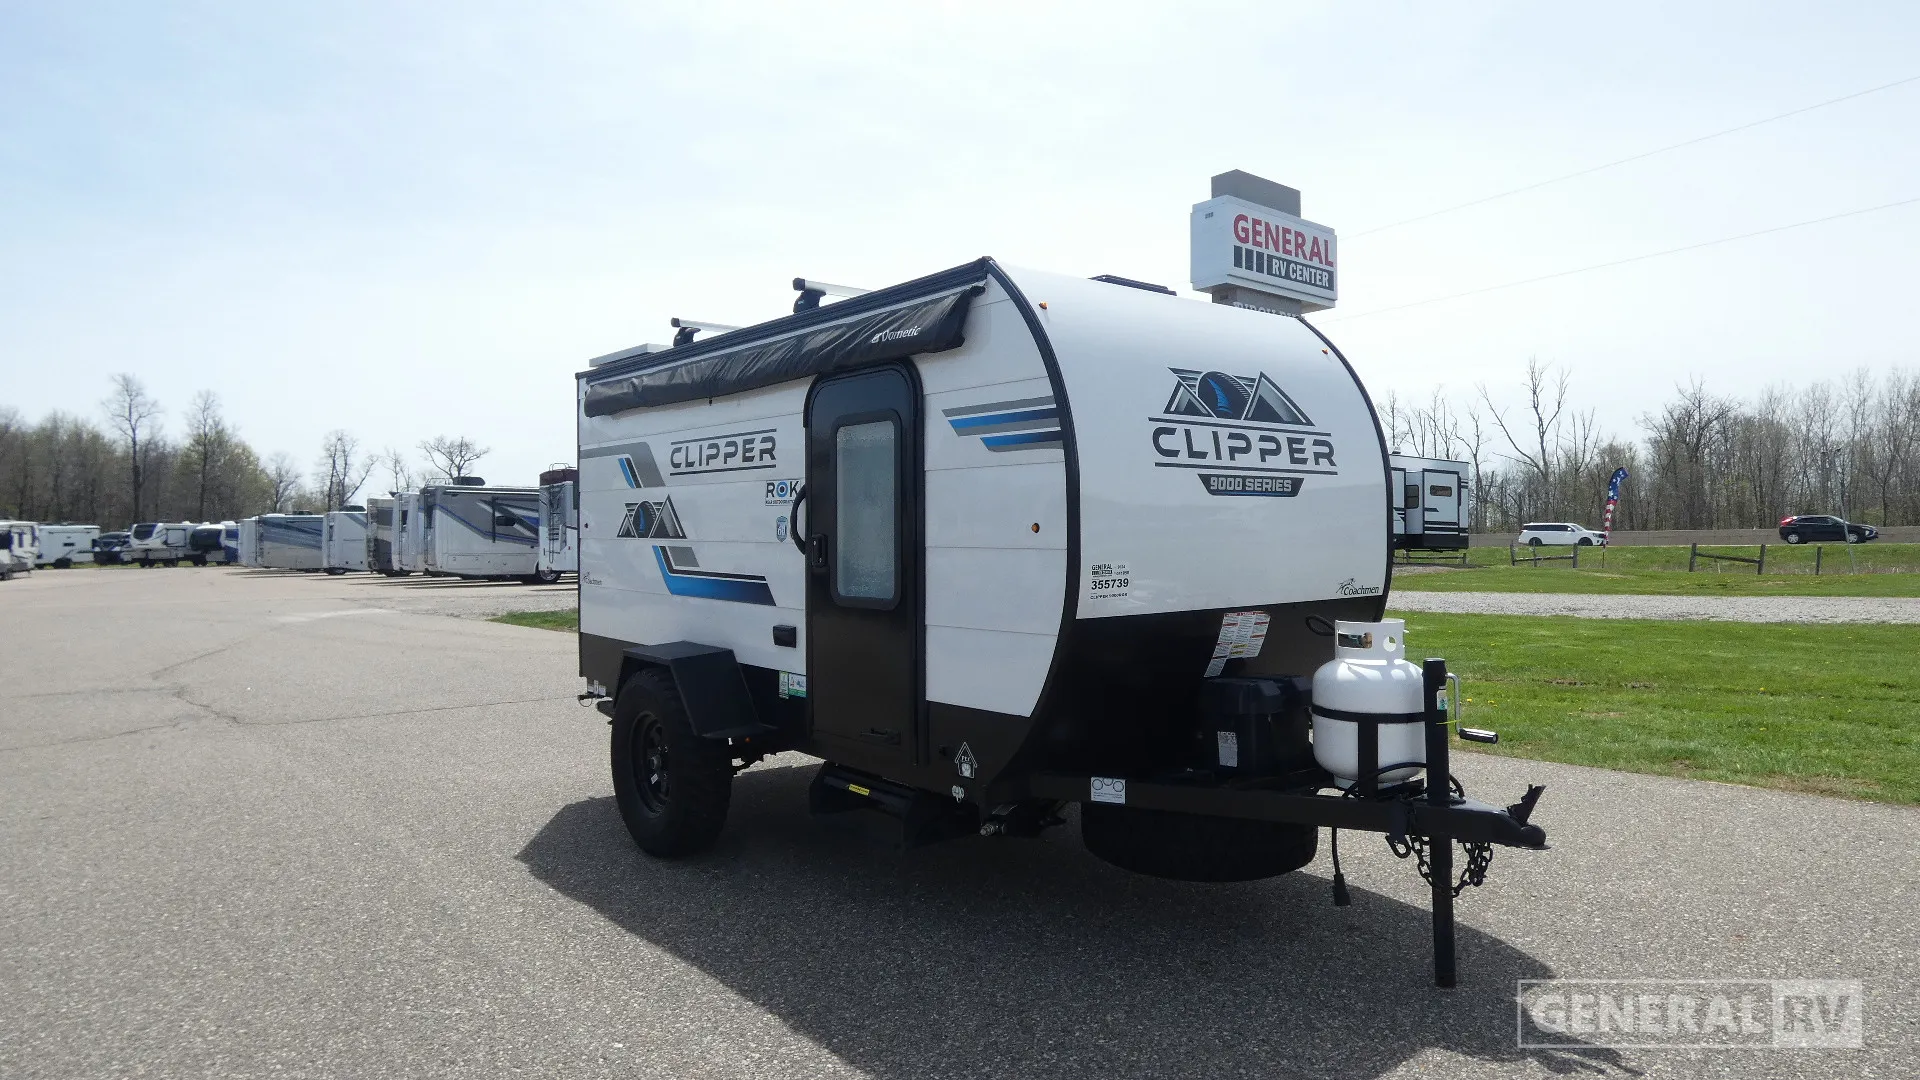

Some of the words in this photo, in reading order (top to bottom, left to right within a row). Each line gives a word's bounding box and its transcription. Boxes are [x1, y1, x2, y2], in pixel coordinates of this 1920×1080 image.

[1233, 213, 1334, 267] GENERAL
[1272, 258, 1287, 276] RV
[1289, 263, 1329, 288] CENTER
[881, 325, 921, 342] Dometic
[669, 435, 777, 469] CLIPPER
[1152, 426, 1337, 467] CLIPPER
[766, 481, 799, 498] ROK
[1210, 476, 1243, 491] 9000
[1245, 478, 1292, 492] SERIES
[1091, 578, 1129, 590] 355739
[1342, 583, 1380, 596] Coachmen
